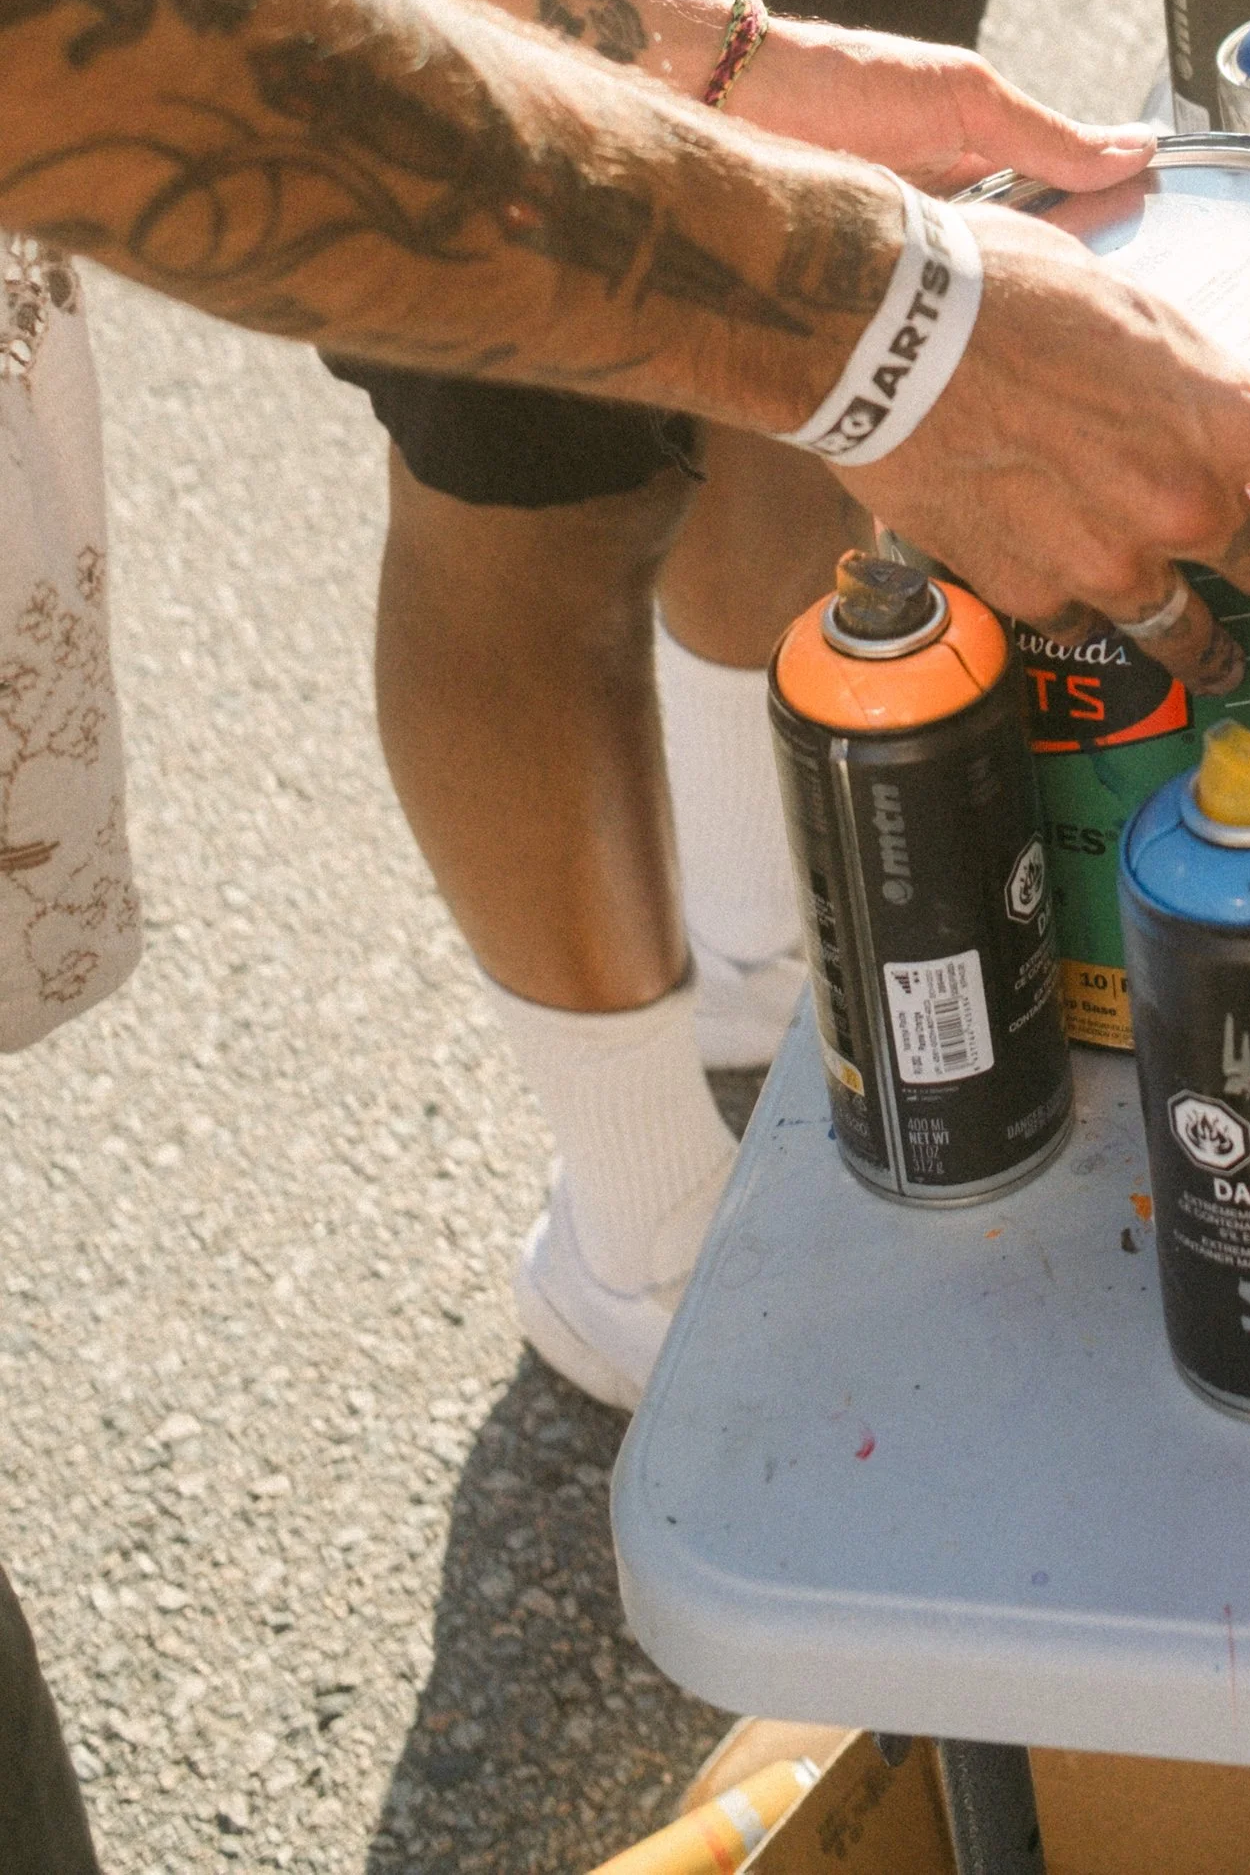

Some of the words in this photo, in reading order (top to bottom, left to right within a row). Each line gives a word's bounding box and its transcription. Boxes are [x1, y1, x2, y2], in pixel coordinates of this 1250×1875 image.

[872, 259, 951, 399] ARTS
[1016, 632, 1132, 666] wards
[1027, 668, 1105, 721] TS
[872, 783, 912, 877] mtn
[908, 1118, 929, 1132] 400
[909, 1131, 930, 1146] NET
[932, 1130, 950, 1145] WT
